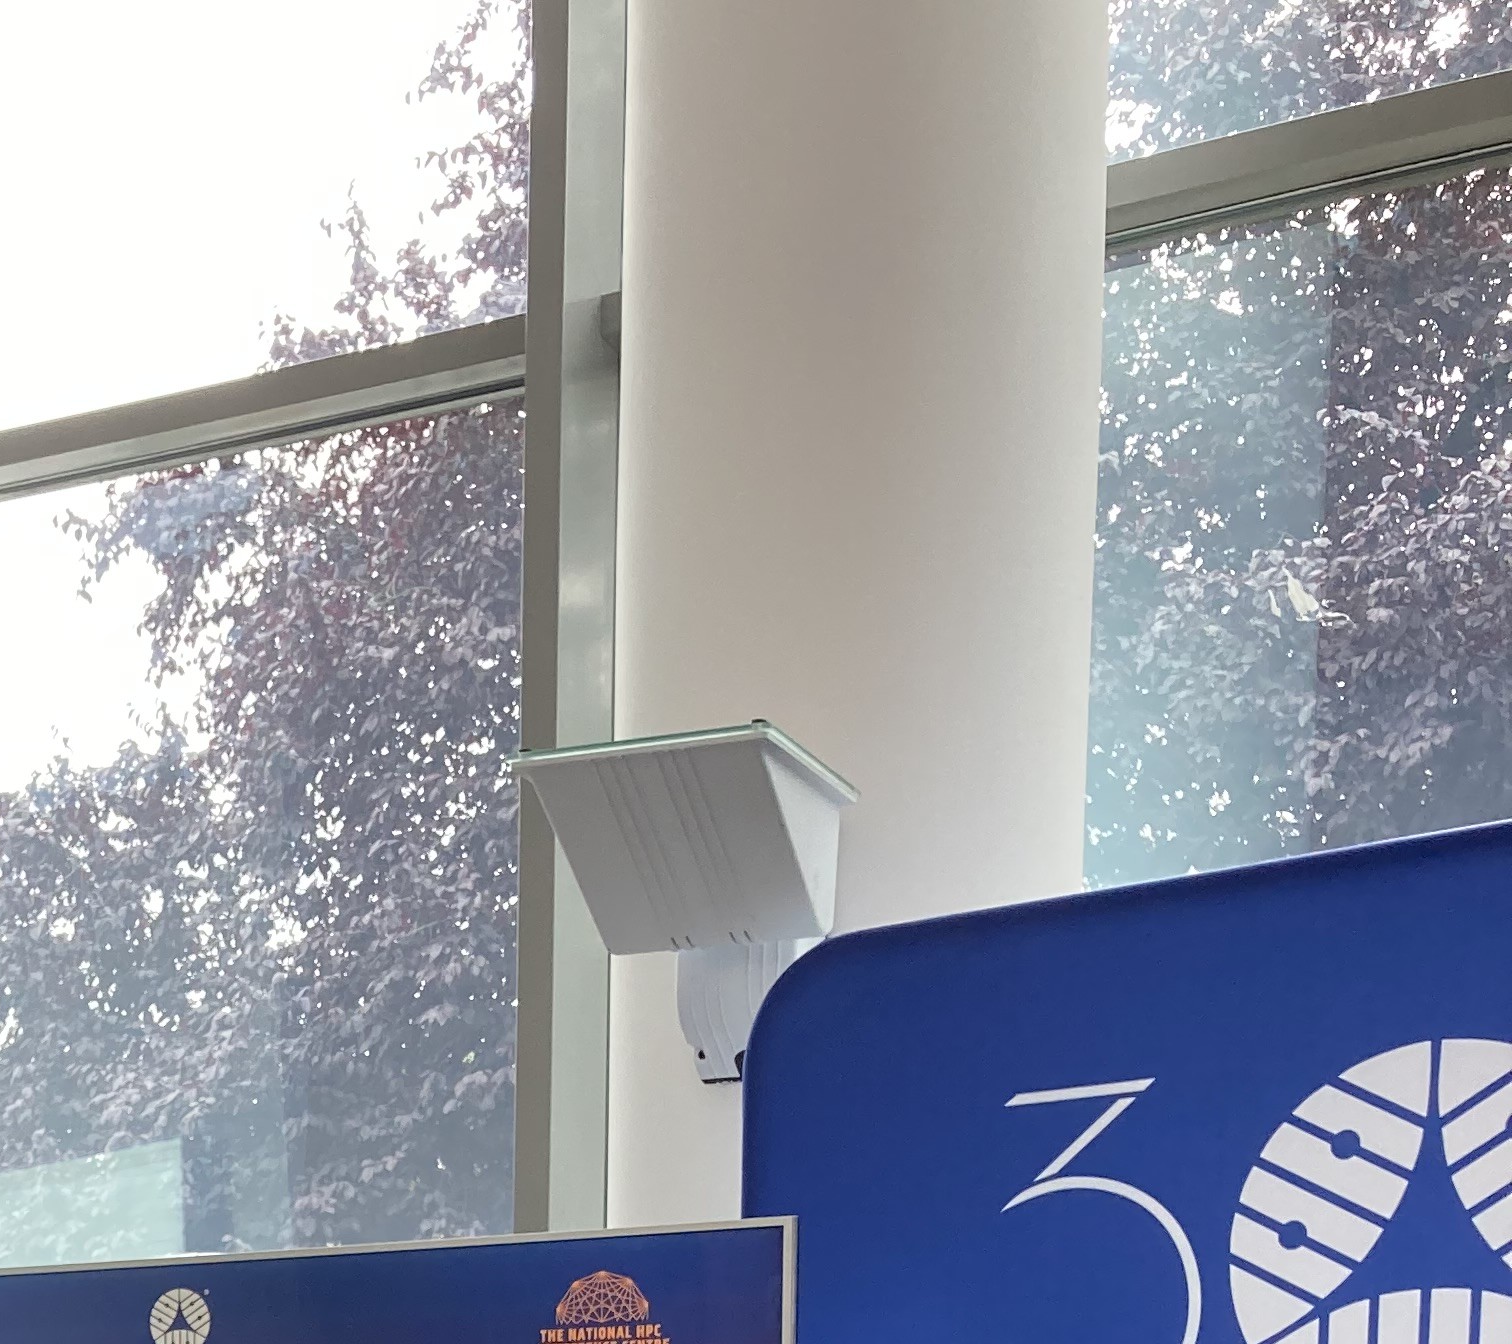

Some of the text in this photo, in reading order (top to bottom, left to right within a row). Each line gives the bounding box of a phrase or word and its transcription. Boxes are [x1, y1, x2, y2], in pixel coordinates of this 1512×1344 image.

[540, 1323, 661, 1343] THE NATIONAL HPC
